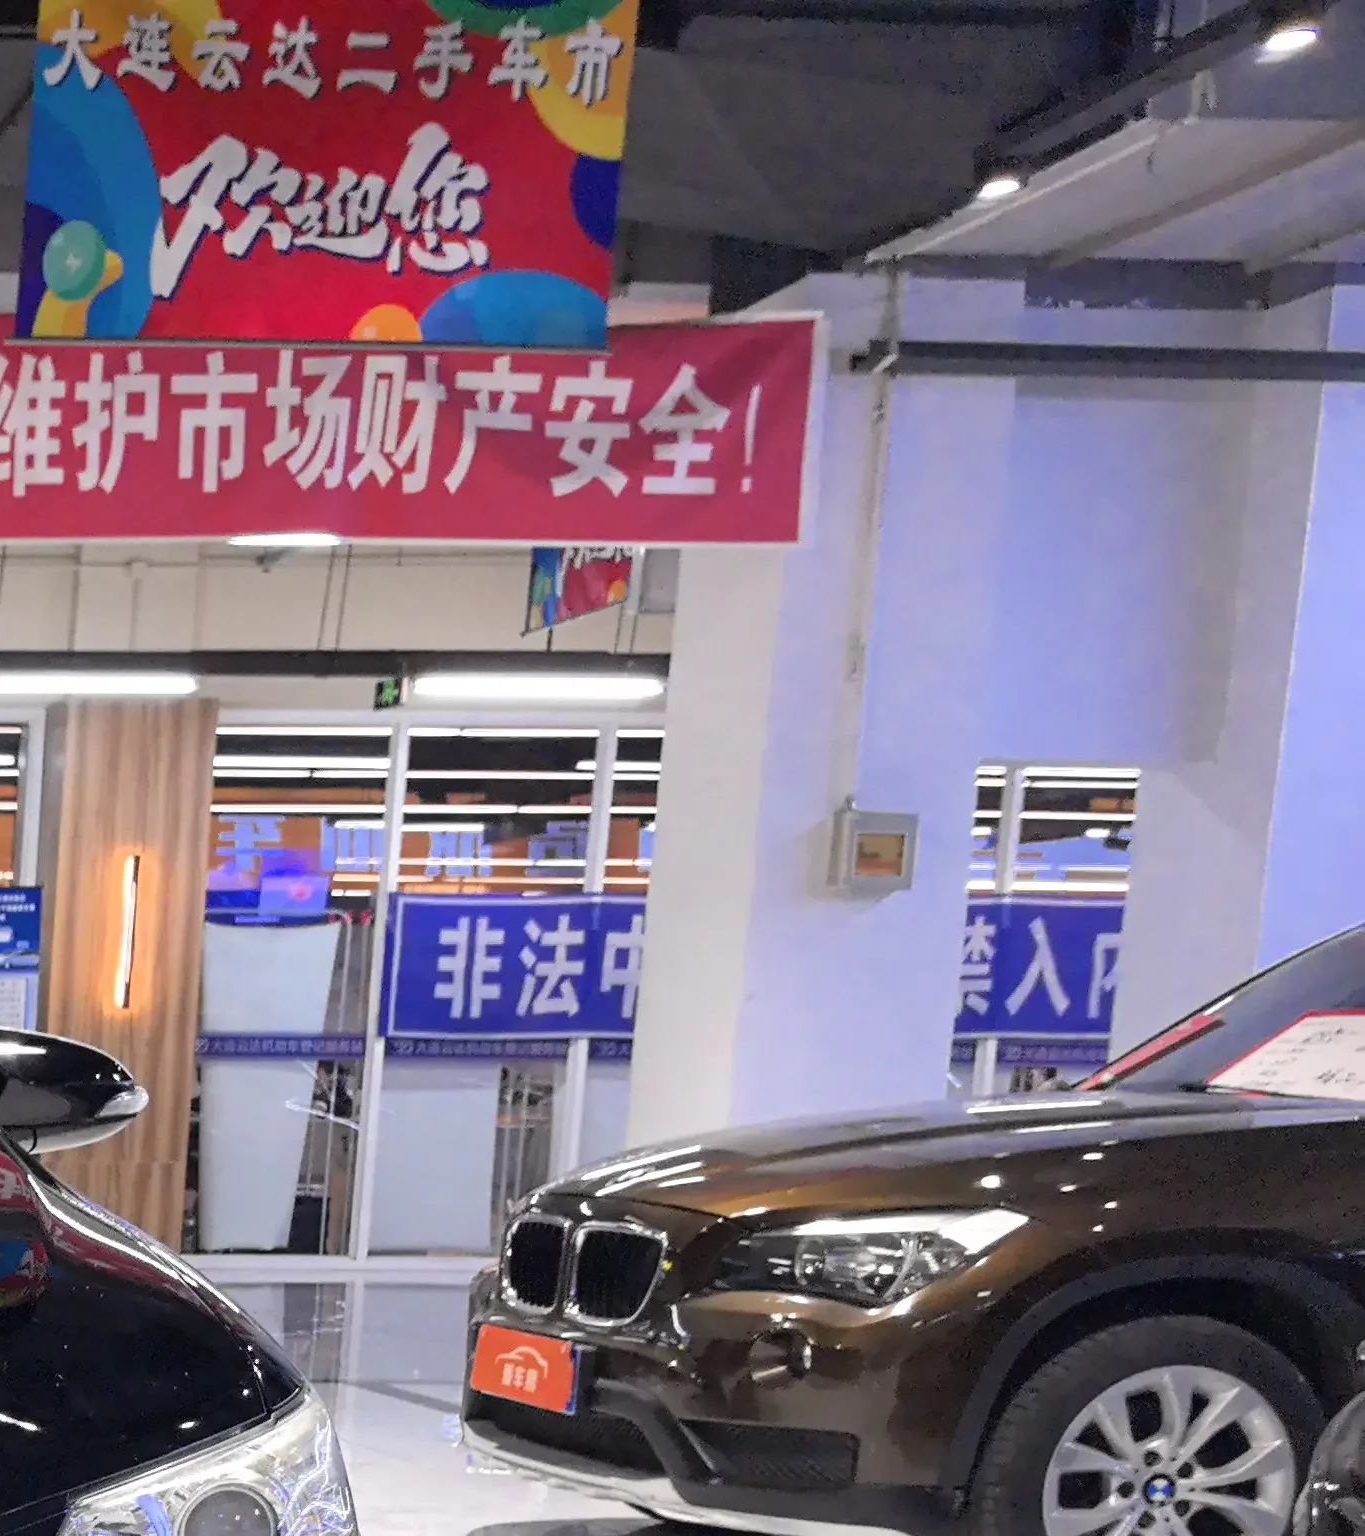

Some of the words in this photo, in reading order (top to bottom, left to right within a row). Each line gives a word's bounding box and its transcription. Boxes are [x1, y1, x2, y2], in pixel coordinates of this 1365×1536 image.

[43, 16, 623, 106] 大连云达二手车市
[150, 121, 492, 300] 欢迎您
[433, 914, 645, 1020] 非法中
